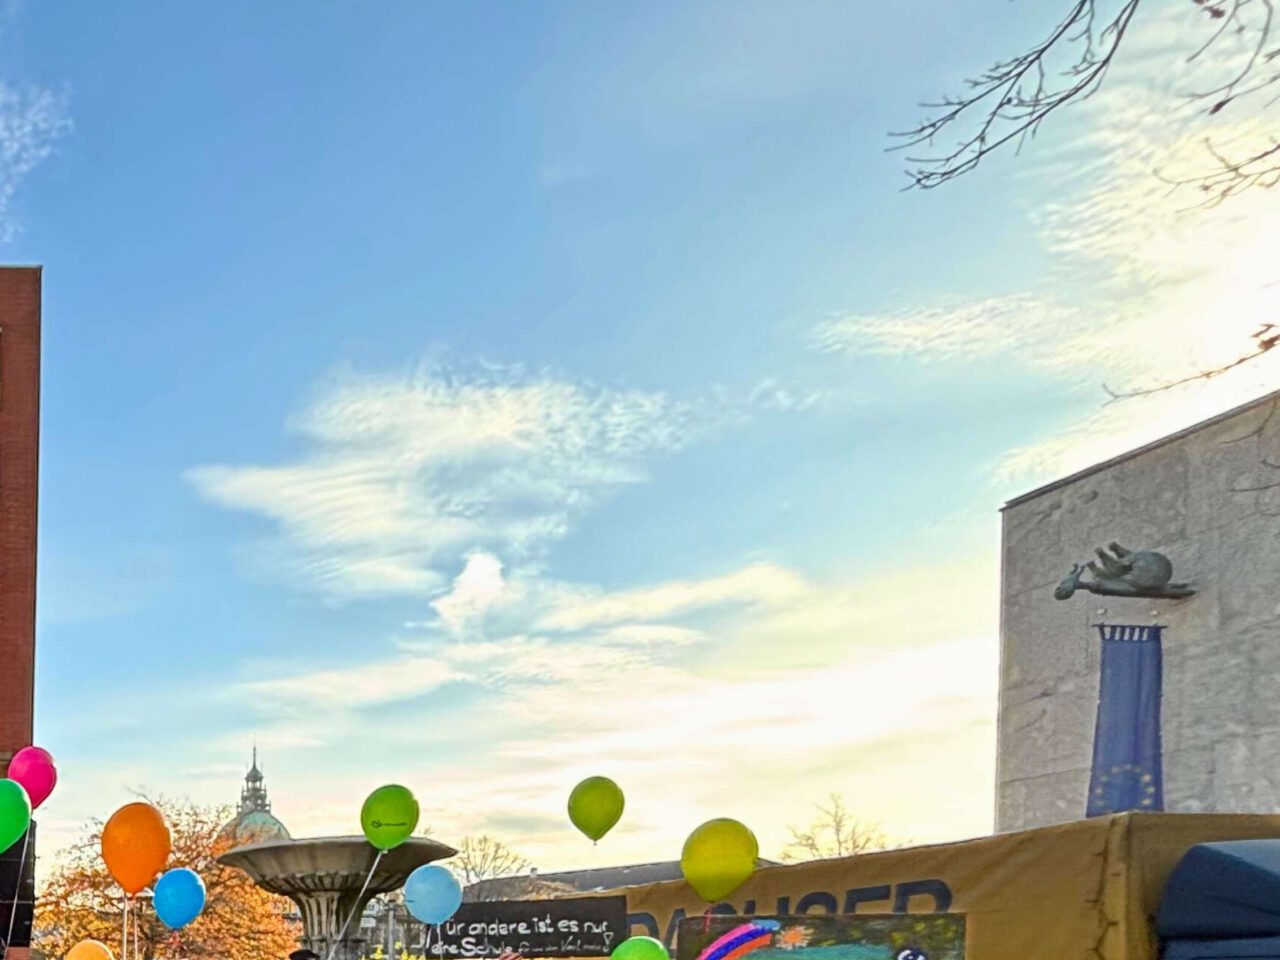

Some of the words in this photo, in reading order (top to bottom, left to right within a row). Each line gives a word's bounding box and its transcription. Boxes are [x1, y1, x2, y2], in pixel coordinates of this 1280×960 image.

[469, 917, 531, 936] andere
[532, 914, 556, 934] ist
[558, 919, 579, 932] es
[460, 936, 513, 957] Schule
